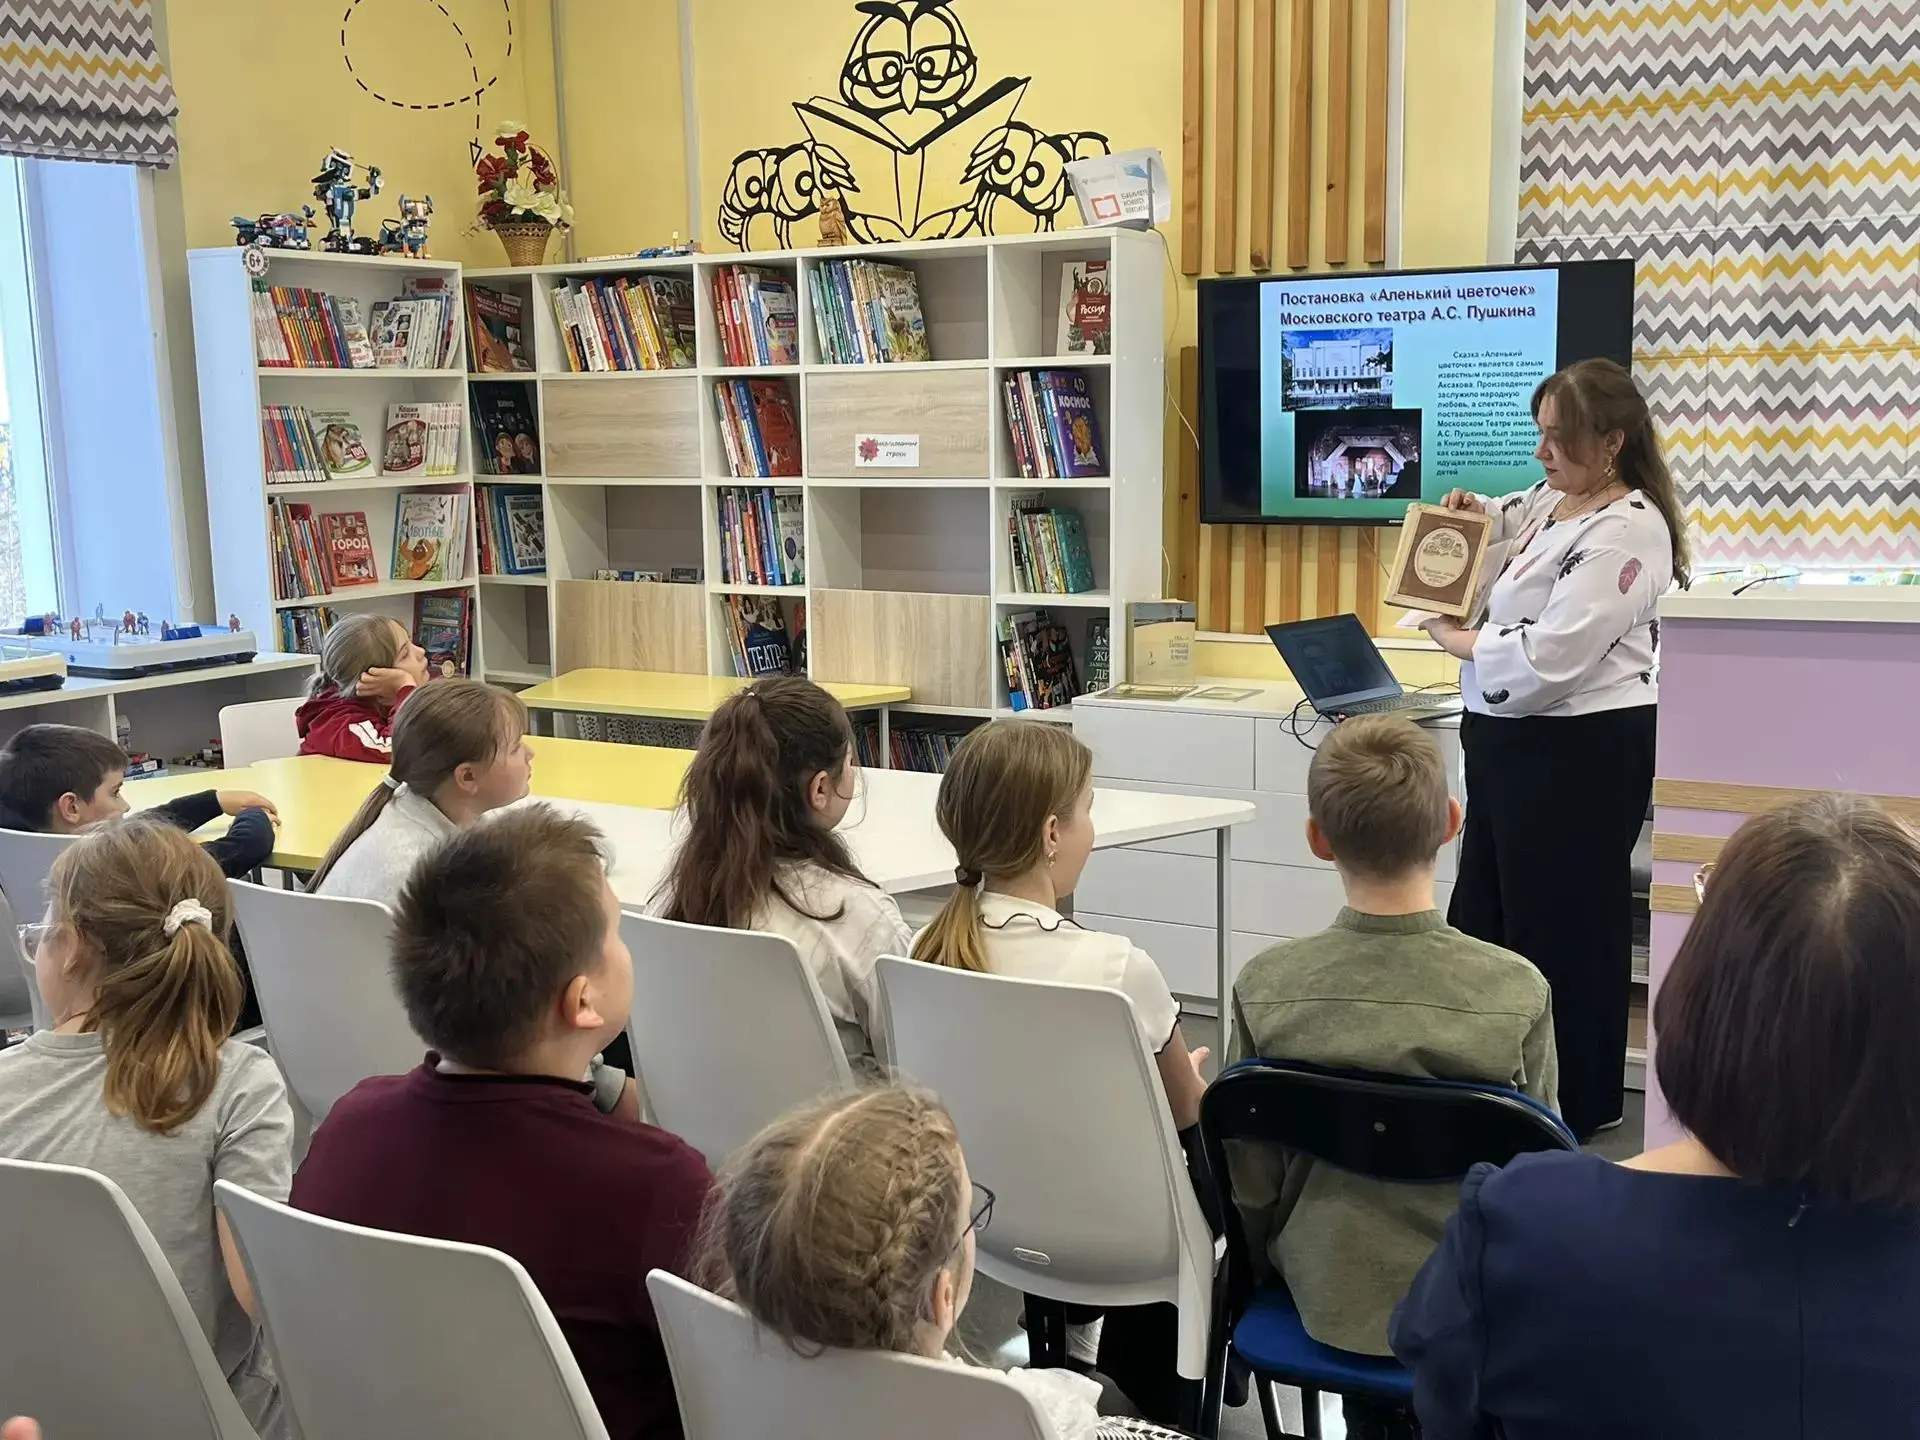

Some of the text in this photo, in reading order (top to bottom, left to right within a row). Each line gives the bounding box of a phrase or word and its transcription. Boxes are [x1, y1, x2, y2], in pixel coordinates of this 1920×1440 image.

[250, 253, 261, 267] 6+
[1280, 285, 1536, 305] Постановка «Аленький цветочек»
[1280, 305, 1536, 325] Московского театра А.С. Пушкина
[1482, 371, 1543, 379] произведением
[1477, 381, 1532, 389] Произведение
[1438, 391, 1520, 399] заслужило народную
[1058, 395, 1090, 409] КОСМОС
[351, 446, 365, 457] 100
[331, 537, 370, 550] ГОРОД
[747, 644, 782, 672] ТЕАТР
